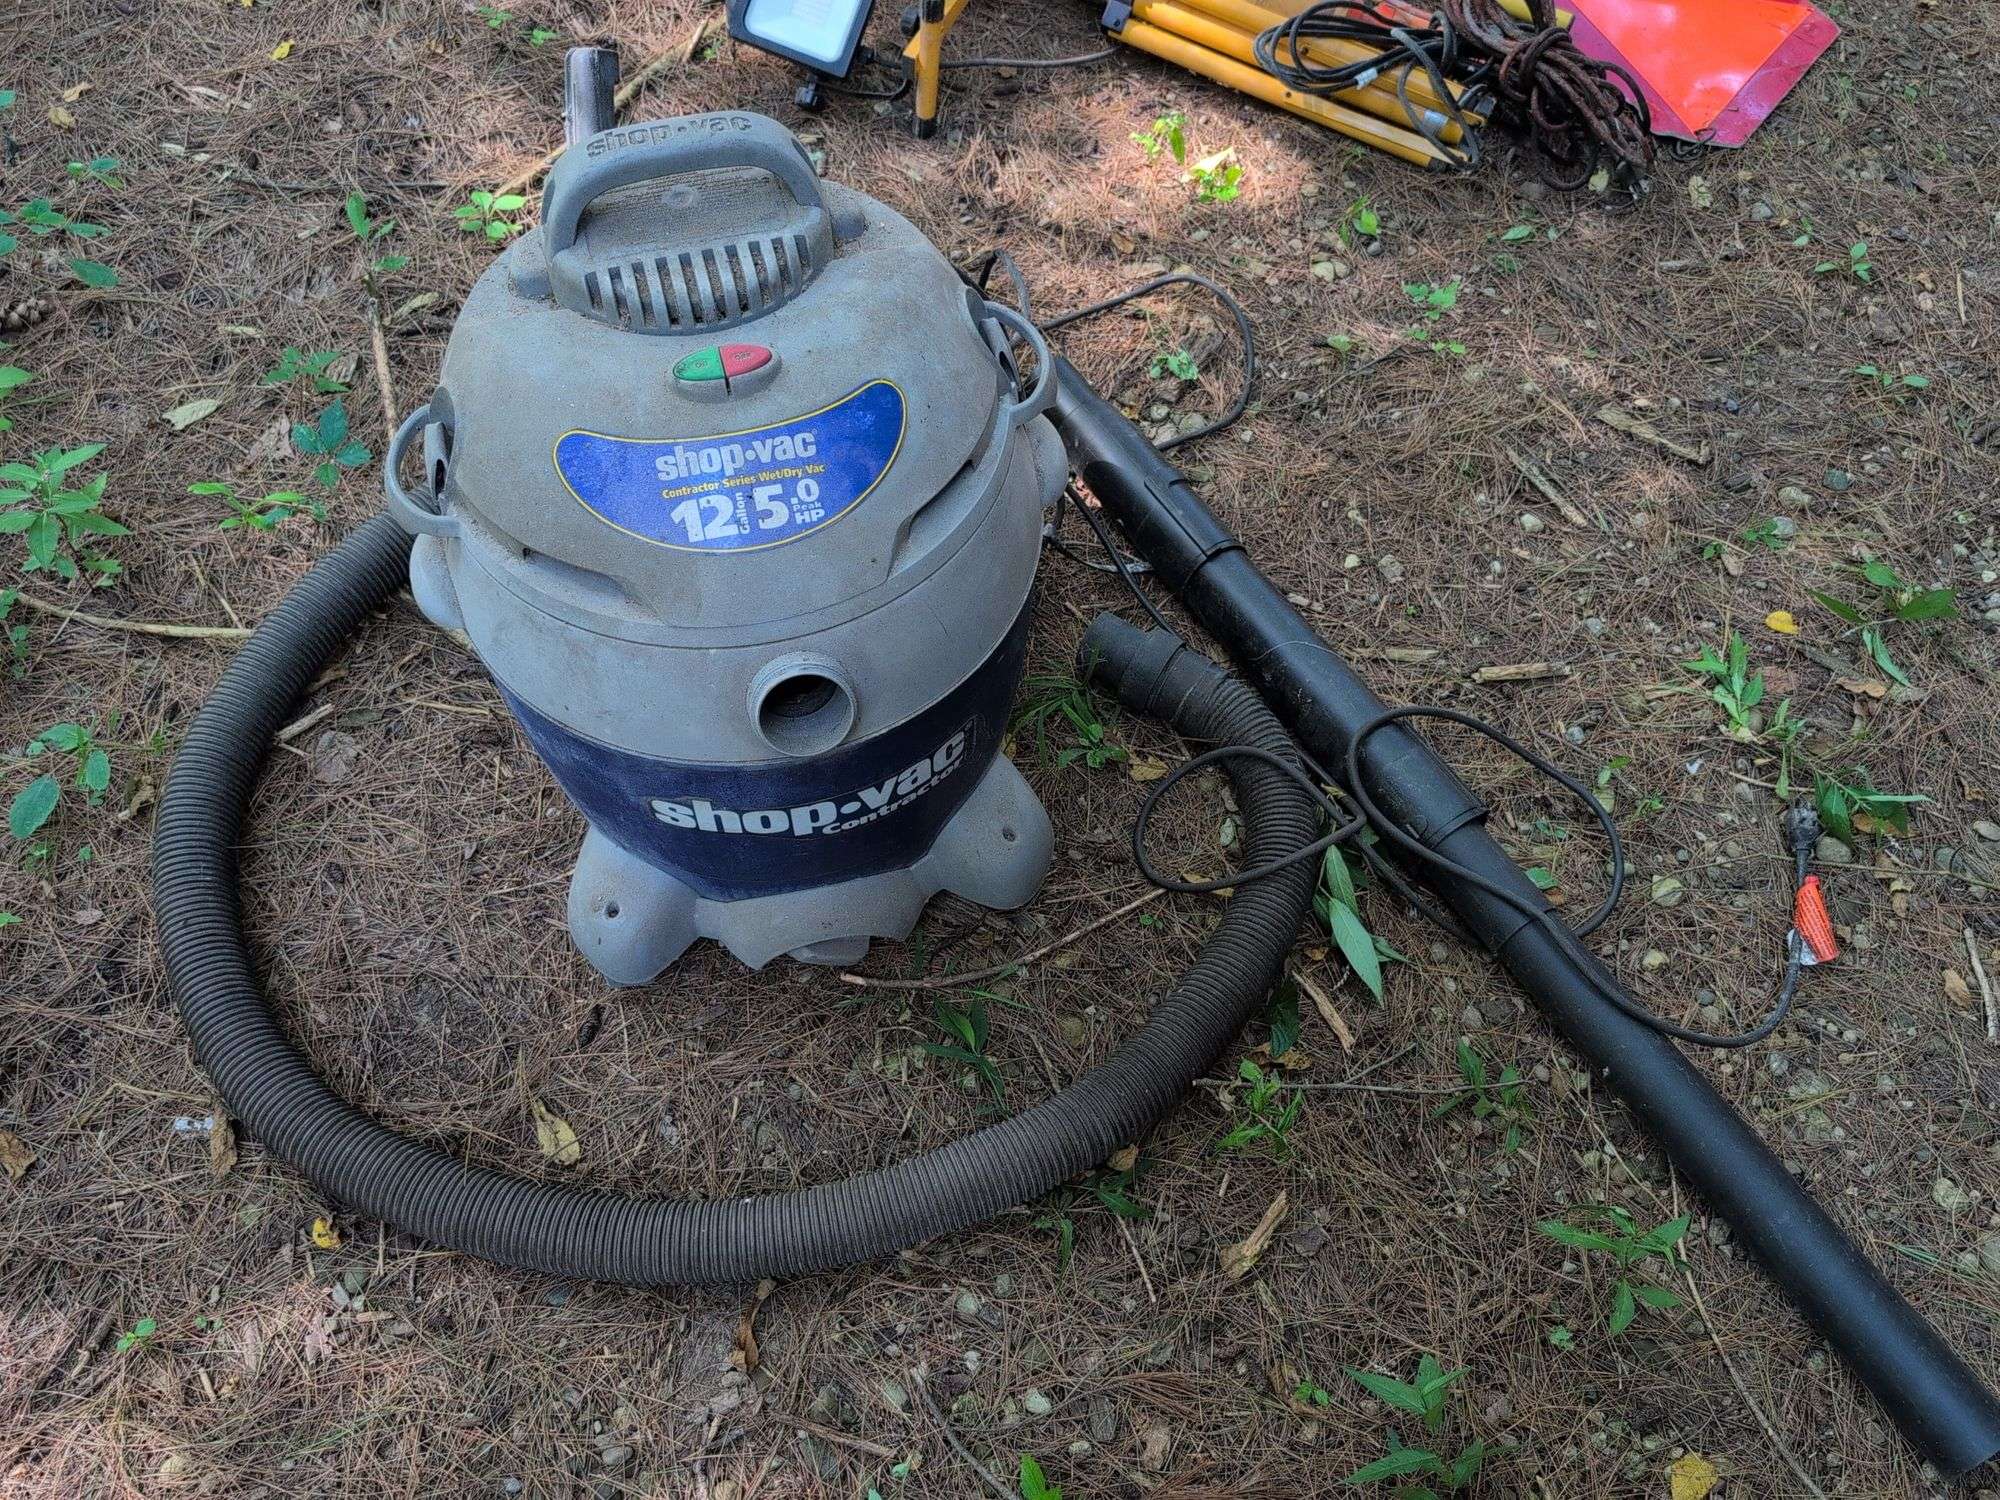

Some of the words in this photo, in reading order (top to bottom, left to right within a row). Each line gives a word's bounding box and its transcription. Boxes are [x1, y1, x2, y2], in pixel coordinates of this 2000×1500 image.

[662, 482, 720, 499] Contractor
[722, 474, 757, 488] Series
[759, 468, 802, 481] Wet/Dry
[805, 464, 826, 474] Vac
[670, 494, 739, 542] 12
[735, 492, 750, 535] Gallon
[793, 501, 822, 511] Peak
[794, 508, 826, 524] HP
[822, 755, 963, 835] Contractor
